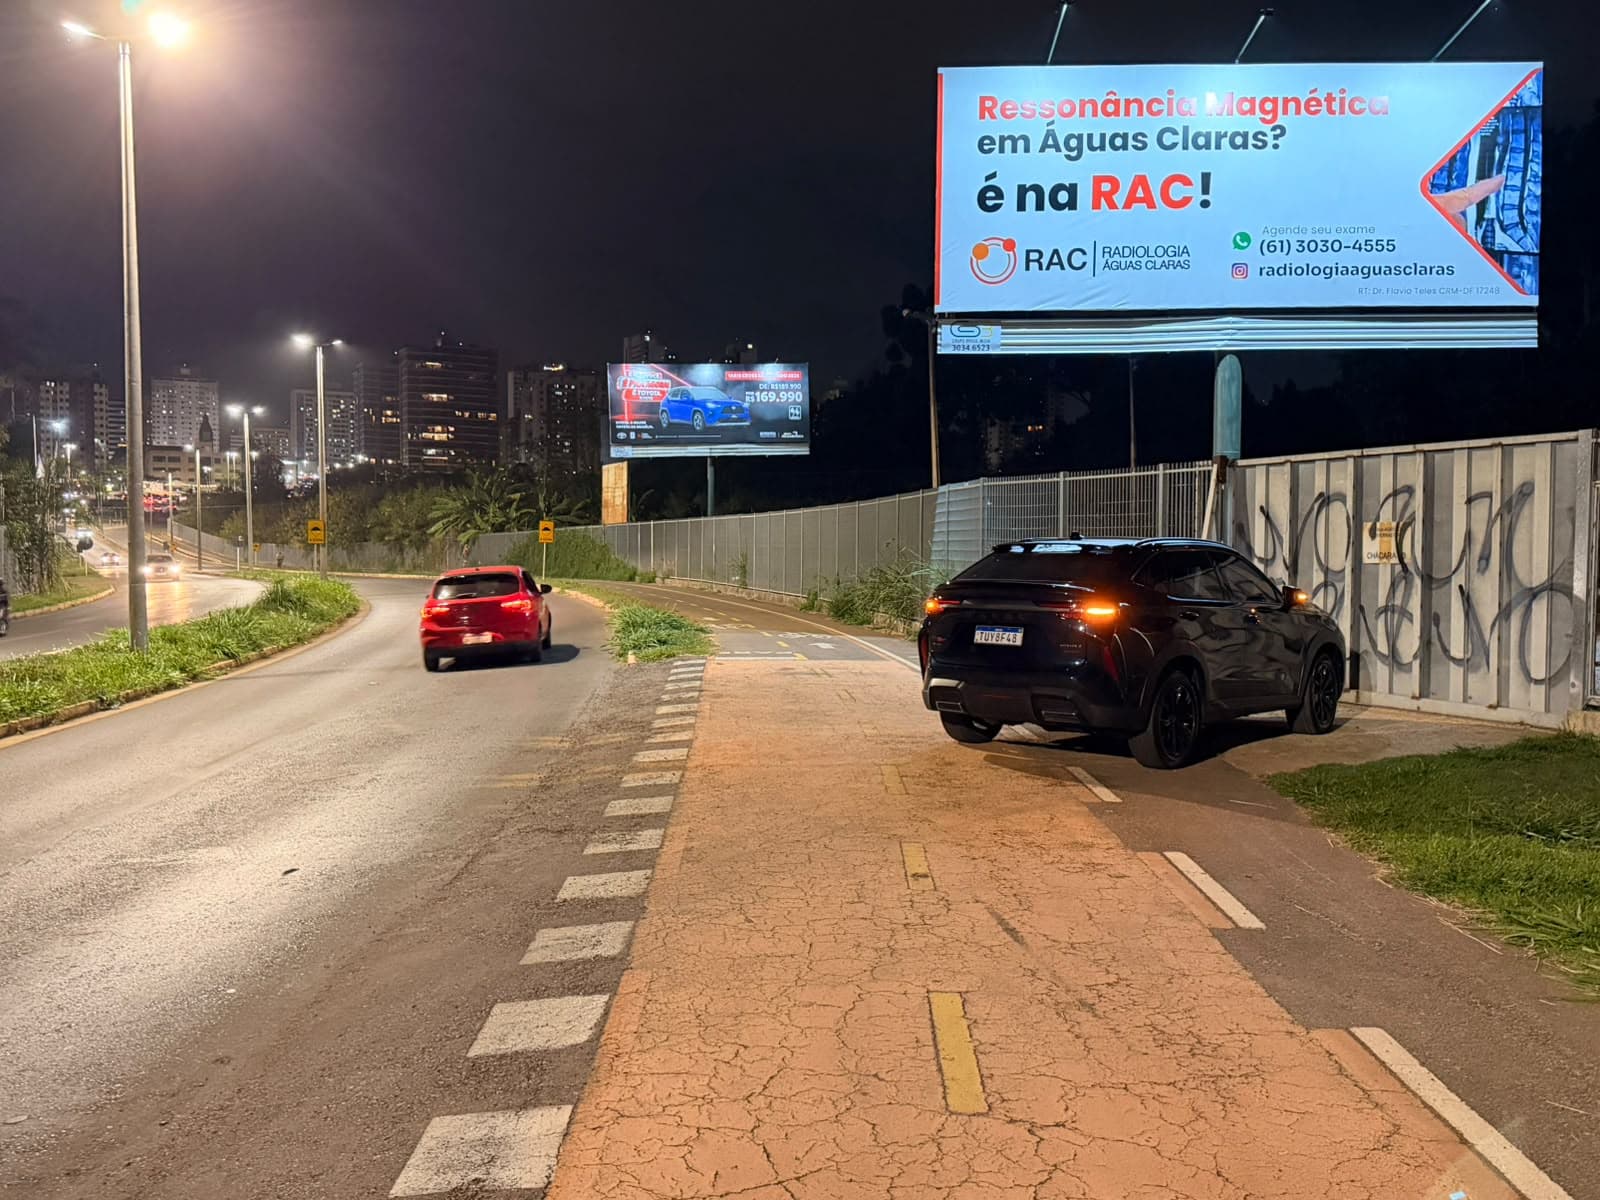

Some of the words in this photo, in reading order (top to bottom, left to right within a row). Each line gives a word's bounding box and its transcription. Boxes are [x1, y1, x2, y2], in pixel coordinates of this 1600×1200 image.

[978, 89, 1197, 121] Ressonância
[1205, 88, 1389, 125] Magnética
[978, 133, 1031, 155] em
[1038, 120, 1149, 162] Águas
[1156, 124, 1287, 151] Claras?
[976, 171, 1005, 213] é
[1016, 182, 1079, 212] na
[1091, 171, 1212, 212] RAC!
[1262, 225, 1308, 237] Agende
[1311, 226, 1332, 235] seu
[1335, 225, 1376, 235] exame
[1259, 239, 1292, 256] (61)
[1296, 238, 1396, 254] 3030-4555
[1024, 248, 1088, 272] RAC
[1102, 245, 1191, 259] RADIOLOGIA
[1102, 258, 1142, 271] ÁGUAS
[1144, 259, 1191, 271] CLARAS
[1259, 262, 1455, 280] radiologiaaguasclaras
[755, 391, 803, 402] 169.990
